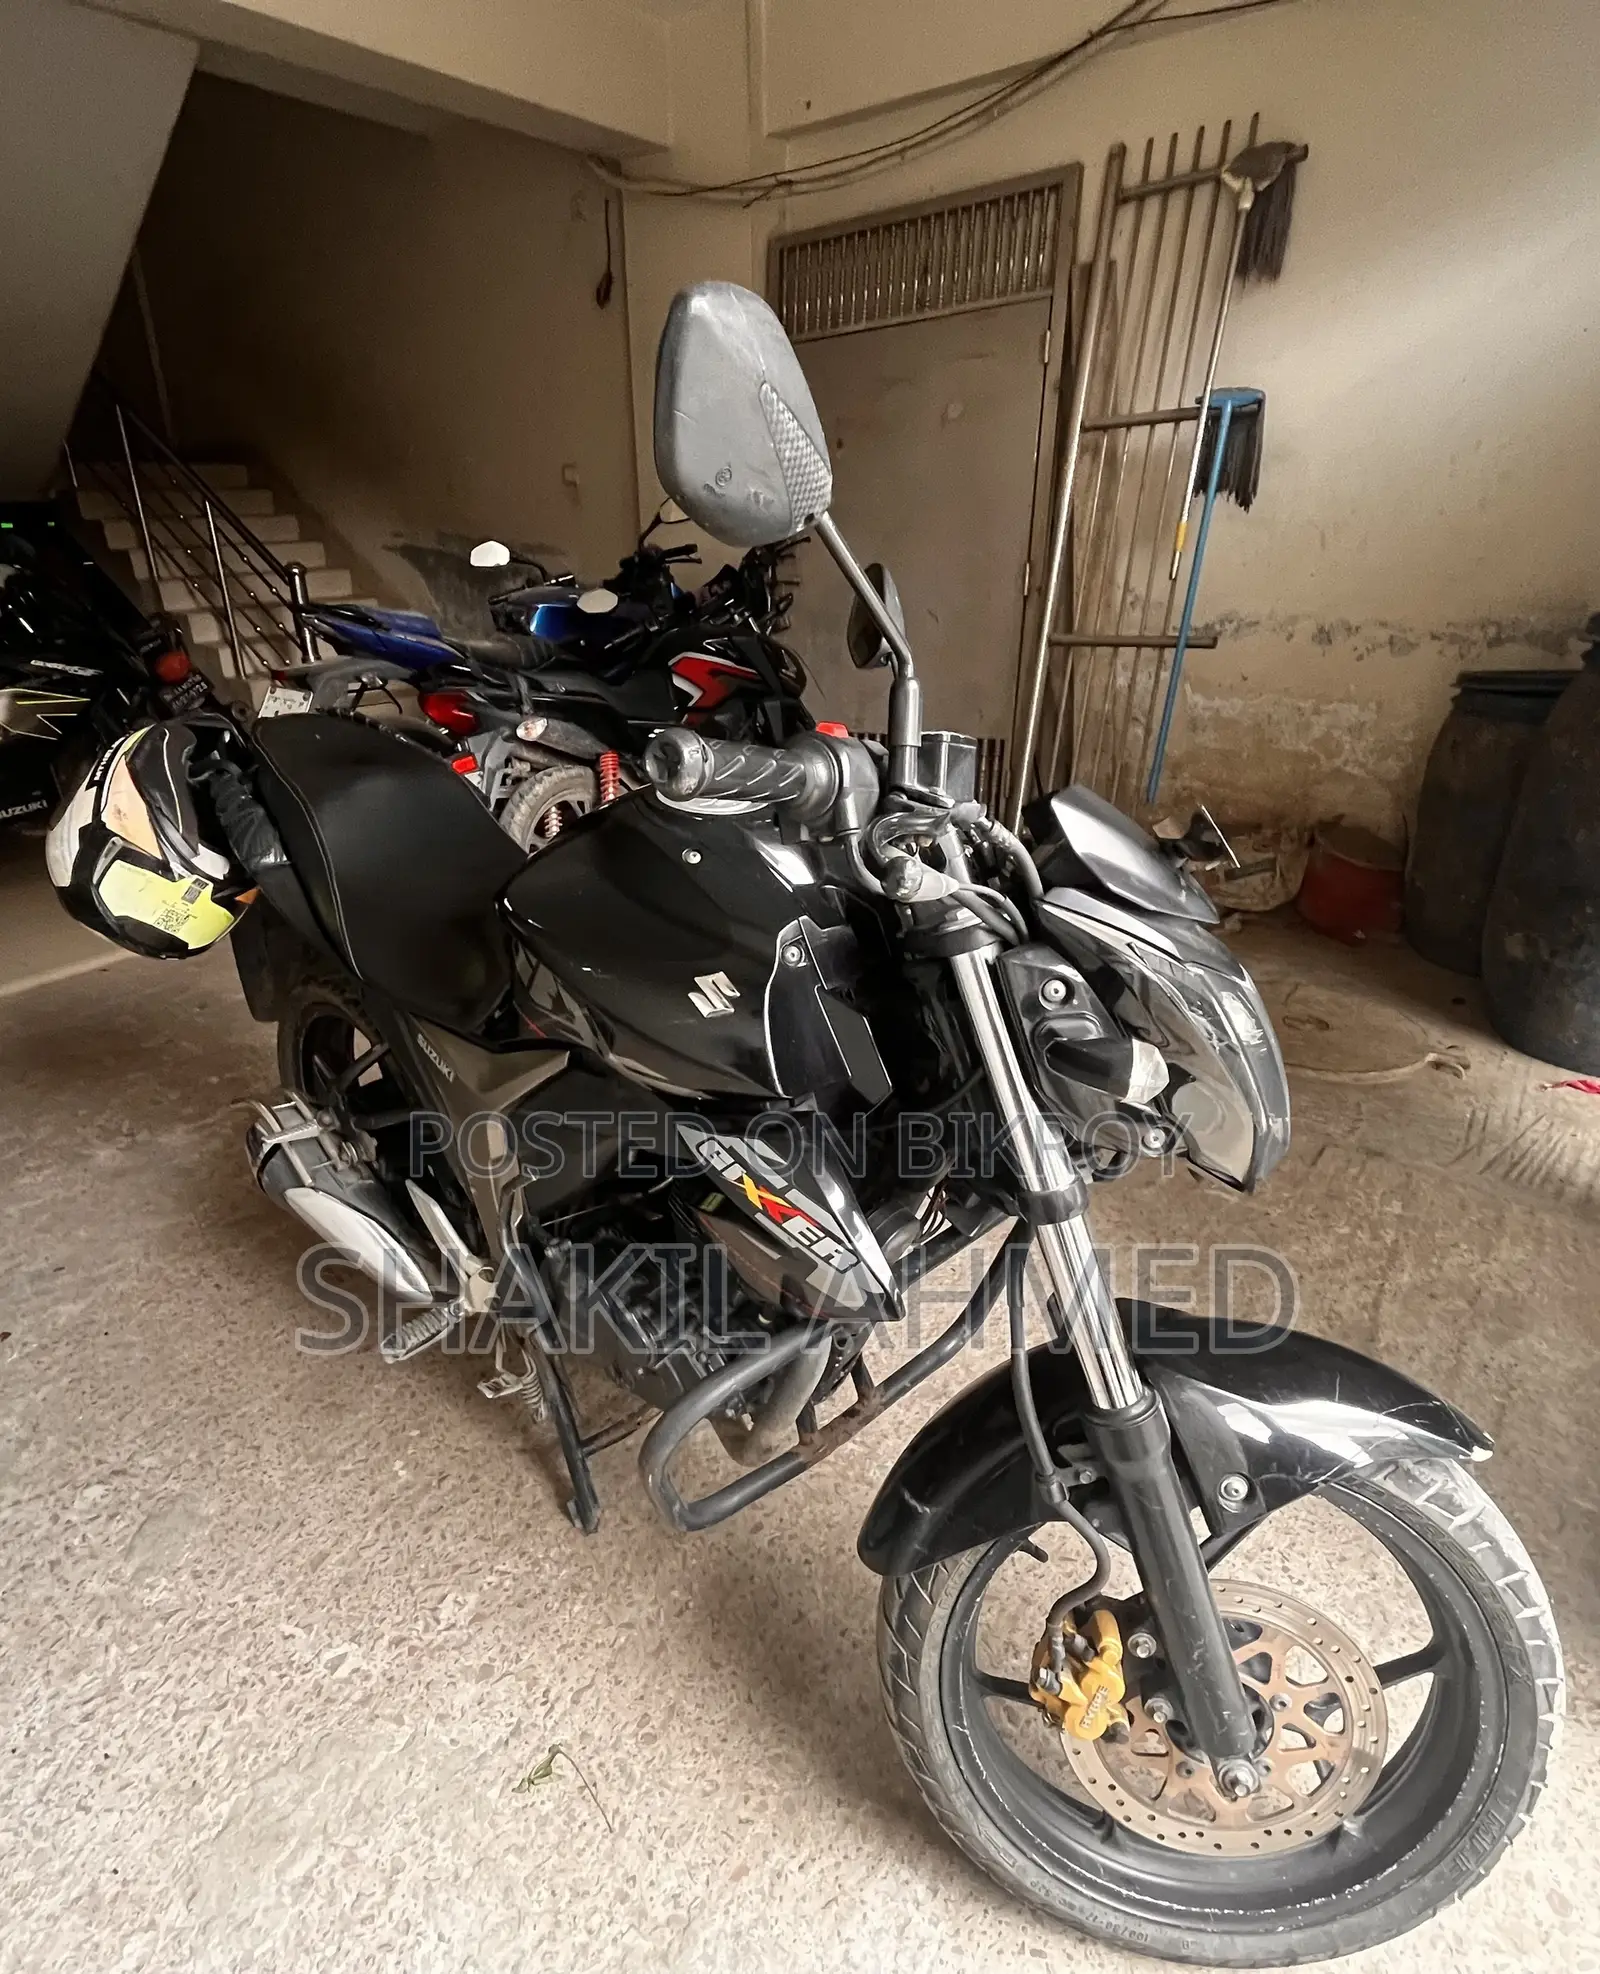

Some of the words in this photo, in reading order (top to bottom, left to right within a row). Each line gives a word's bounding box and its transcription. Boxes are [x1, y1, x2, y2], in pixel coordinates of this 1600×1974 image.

[0, 799, 48, 819] UZUKI
[416, 1033, 454, 1082] SUZUKI
[697, 1138, 859, 1271] GIXXER
